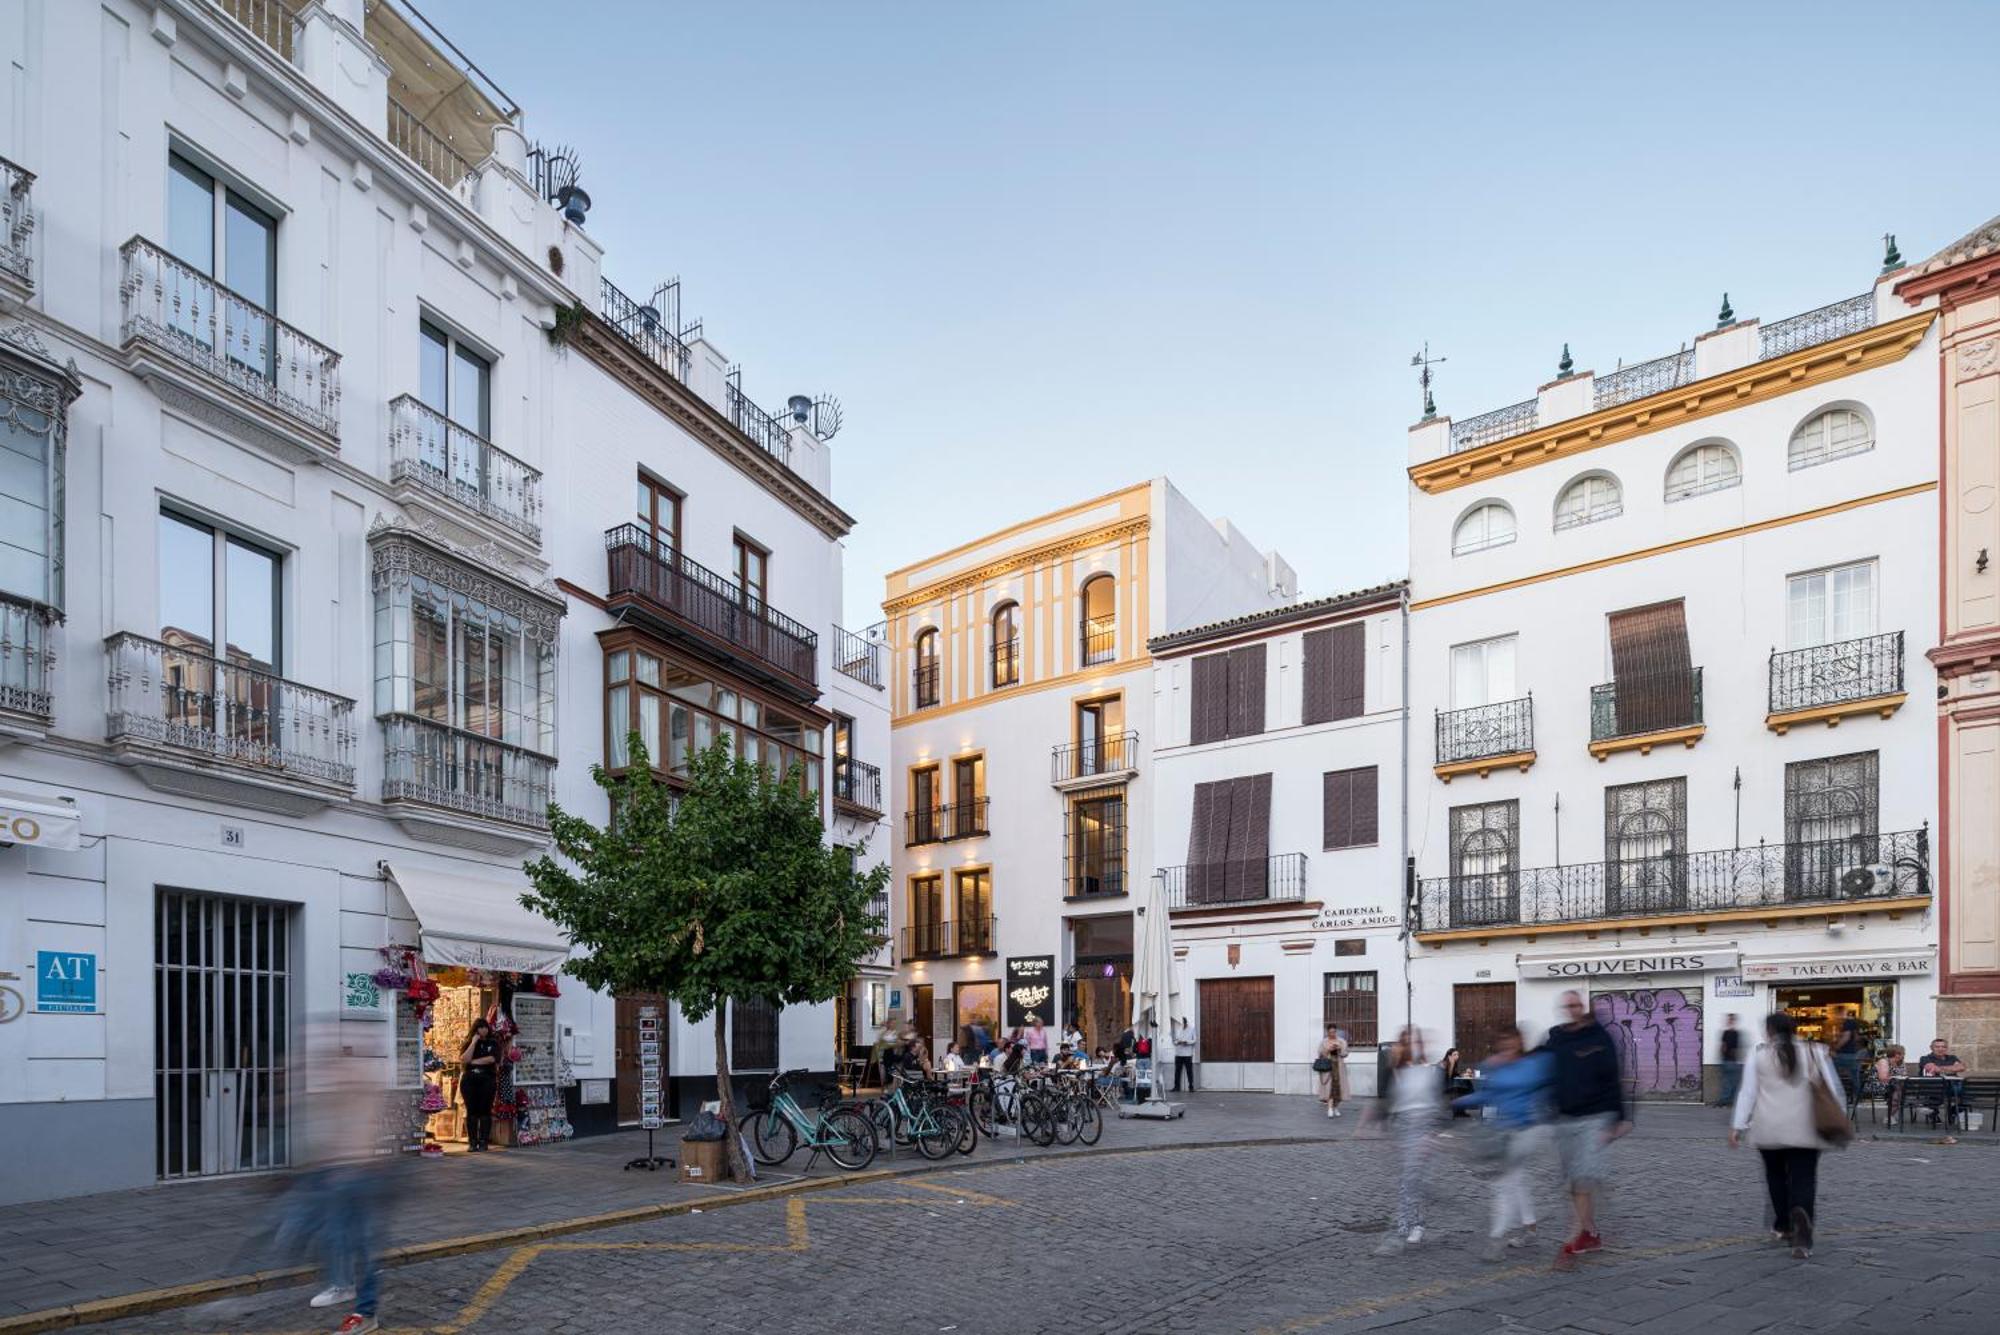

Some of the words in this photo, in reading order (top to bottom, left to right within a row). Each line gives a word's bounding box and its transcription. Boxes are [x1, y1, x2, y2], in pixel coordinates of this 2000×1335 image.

[226, 830, 239, 843] 31
[1324, 906, 1383, 917] CARDENAL
[1312, 919, 1354, 929] CARLOS
[45, 956, 89, 981] AT
[1547, 956, 1705, 976] SOUVENIRS
[1790, 965, 1826, 976] TAKE
[1831, 963, 1875, 974] AWAY
[1880, 962, 1894, 972] &
[1898, 960, 1929, 971] BAR
